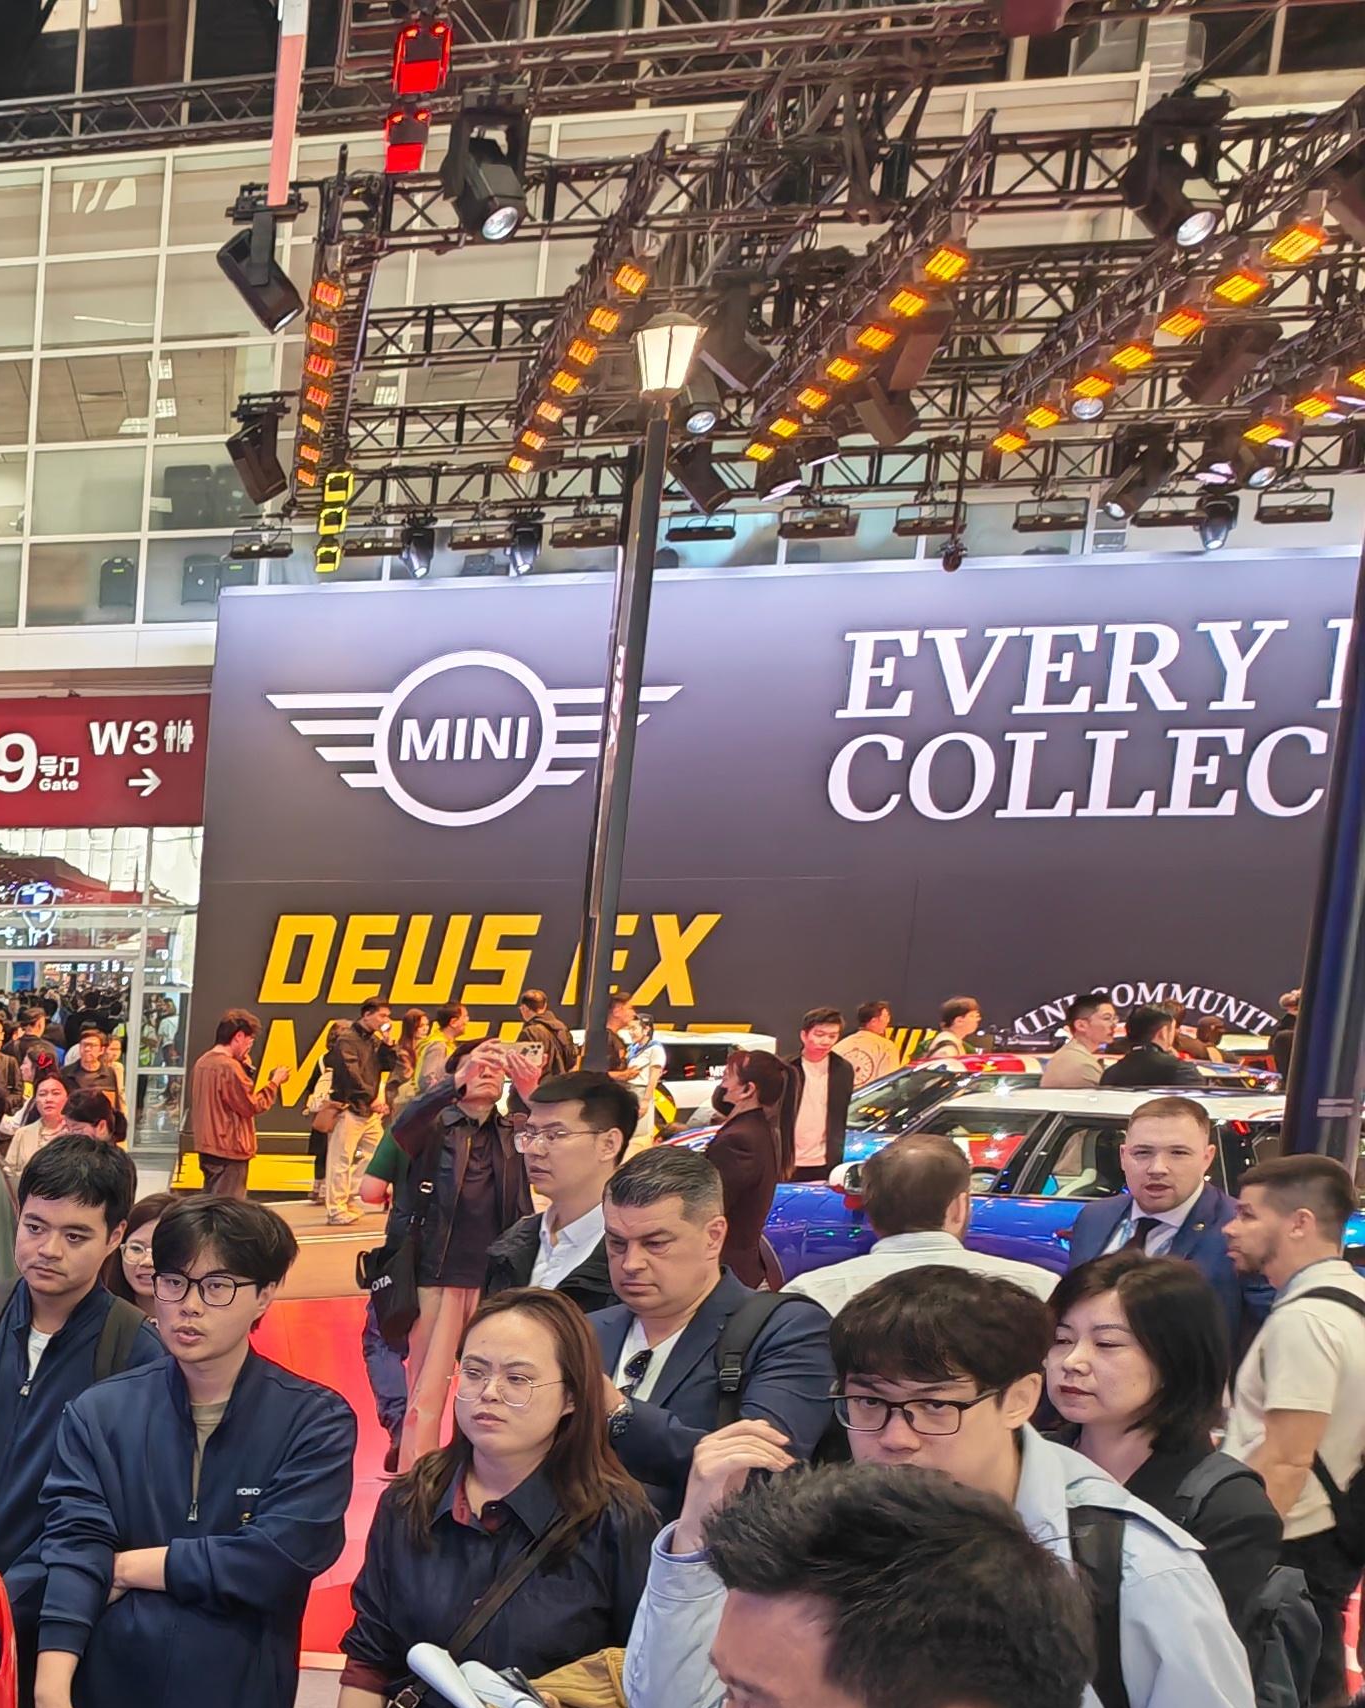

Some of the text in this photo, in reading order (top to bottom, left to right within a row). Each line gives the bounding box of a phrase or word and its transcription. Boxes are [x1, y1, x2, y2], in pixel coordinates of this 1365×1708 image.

[834, 620, 1290, 722] EVERY
[89, 720, 158, 756] W3
[399, 715, 530, 763] MINI
[38, 755, 80, 776] 号门
[39, 778, 80, 791] Gate
[828, 726, 1329, 823] COLLEC
[258, 913, 722, 1007] DEUS EX
[1091, 981, 1278, 1037] COMMUNIT
